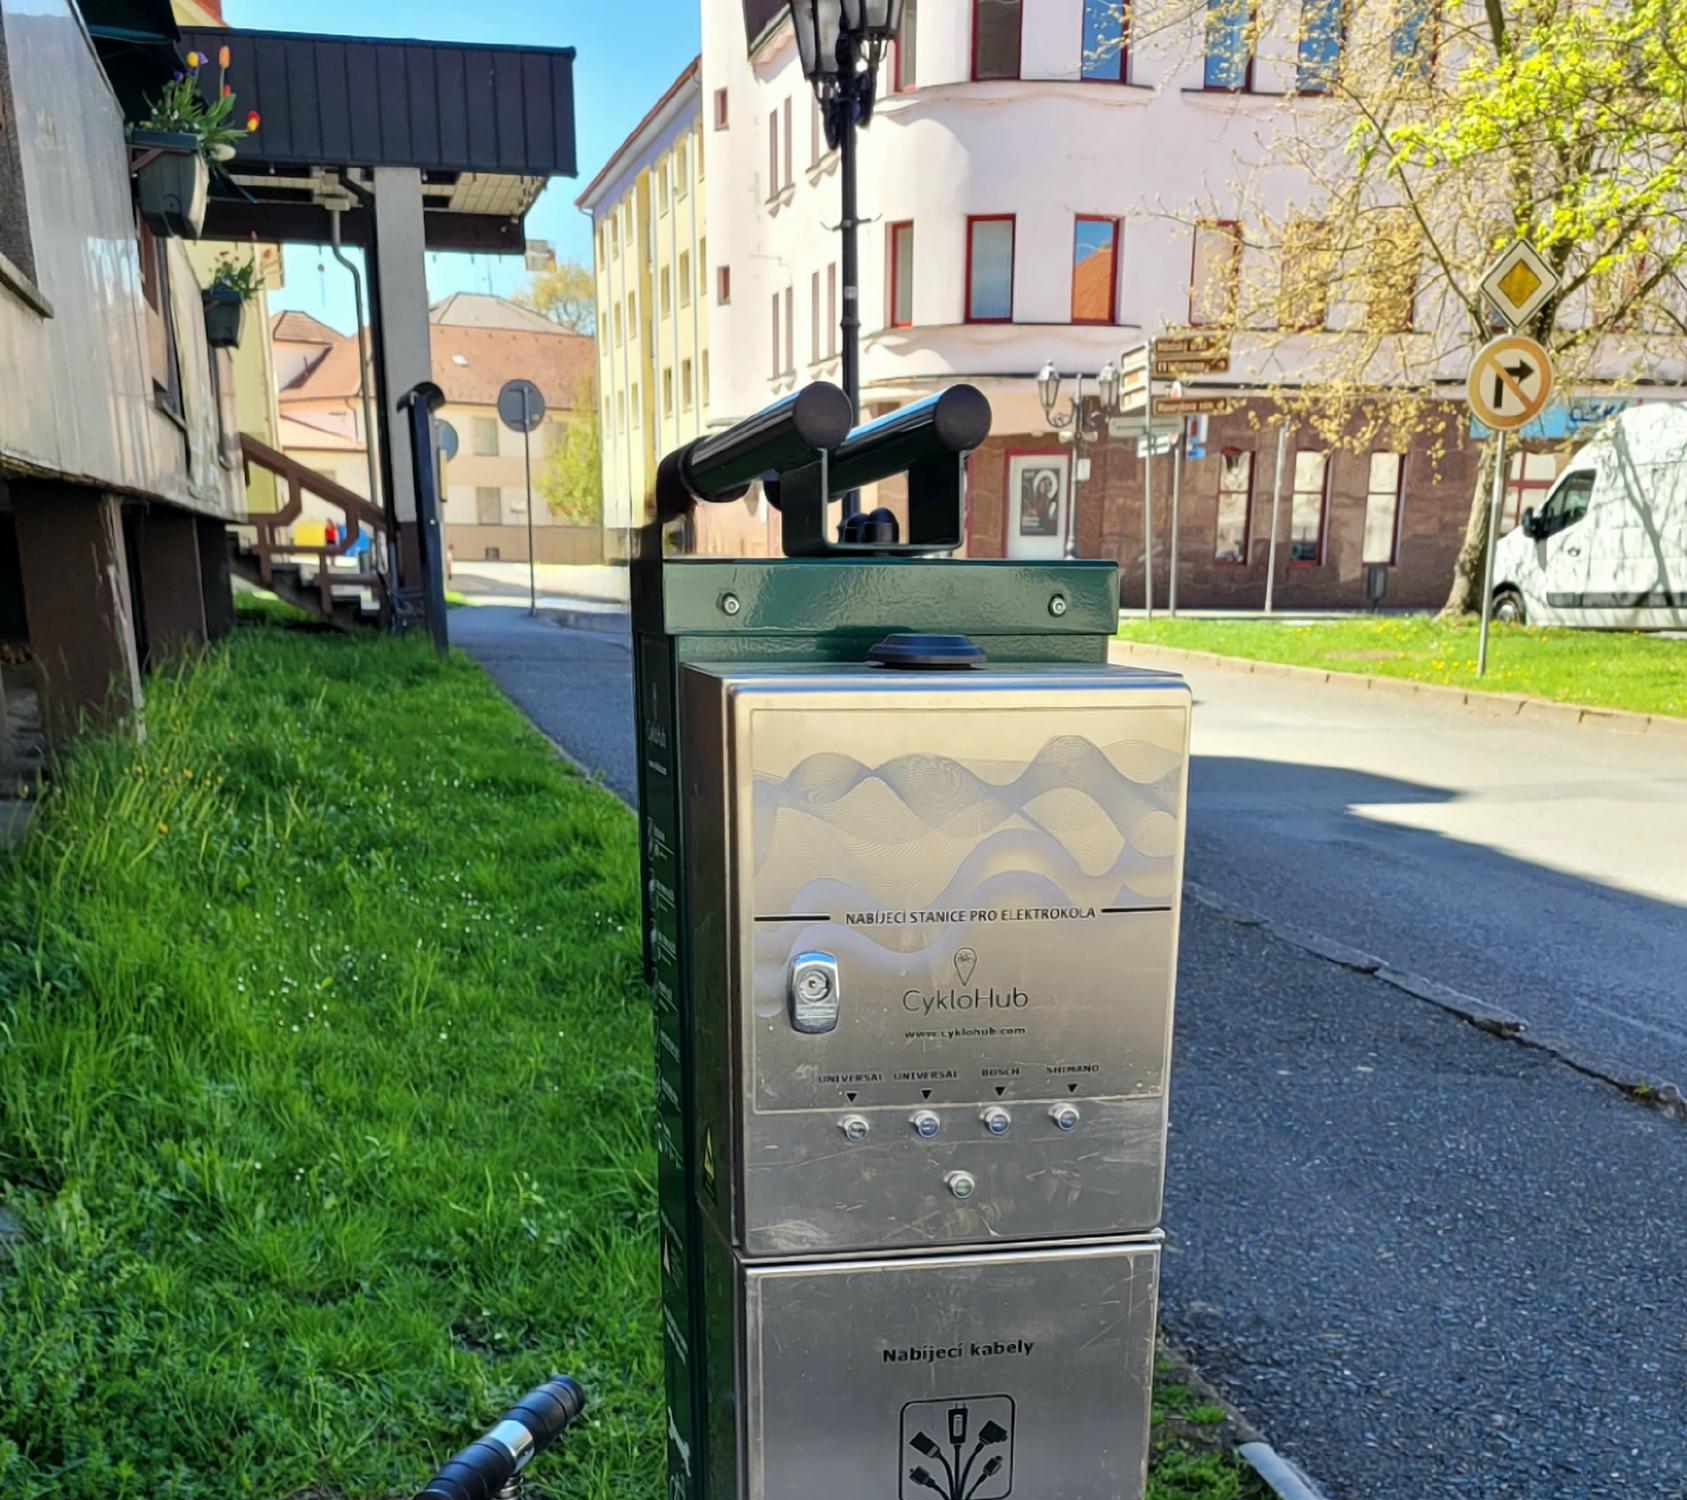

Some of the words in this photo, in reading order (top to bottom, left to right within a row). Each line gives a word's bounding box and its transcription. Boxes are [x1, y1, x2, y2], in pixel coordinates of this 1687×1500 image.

[846, 911, 906, 925] NABÍJECÍ
[909, 910, 967, 923] STANICE
[970, 908, 998, 921] PRO
[1001, 907, 1096, 921] ELEKTROKOLA
[903, 987, 1029, 1016] CykloHub
[981, 1067, 1020, 1077] BOSCH
[1046, 1064, 1099, 1074] SHIMANO
[883, 1343, 963, 1363] Nabíjecí
[970, 1339, 1034, 1357] kabely
